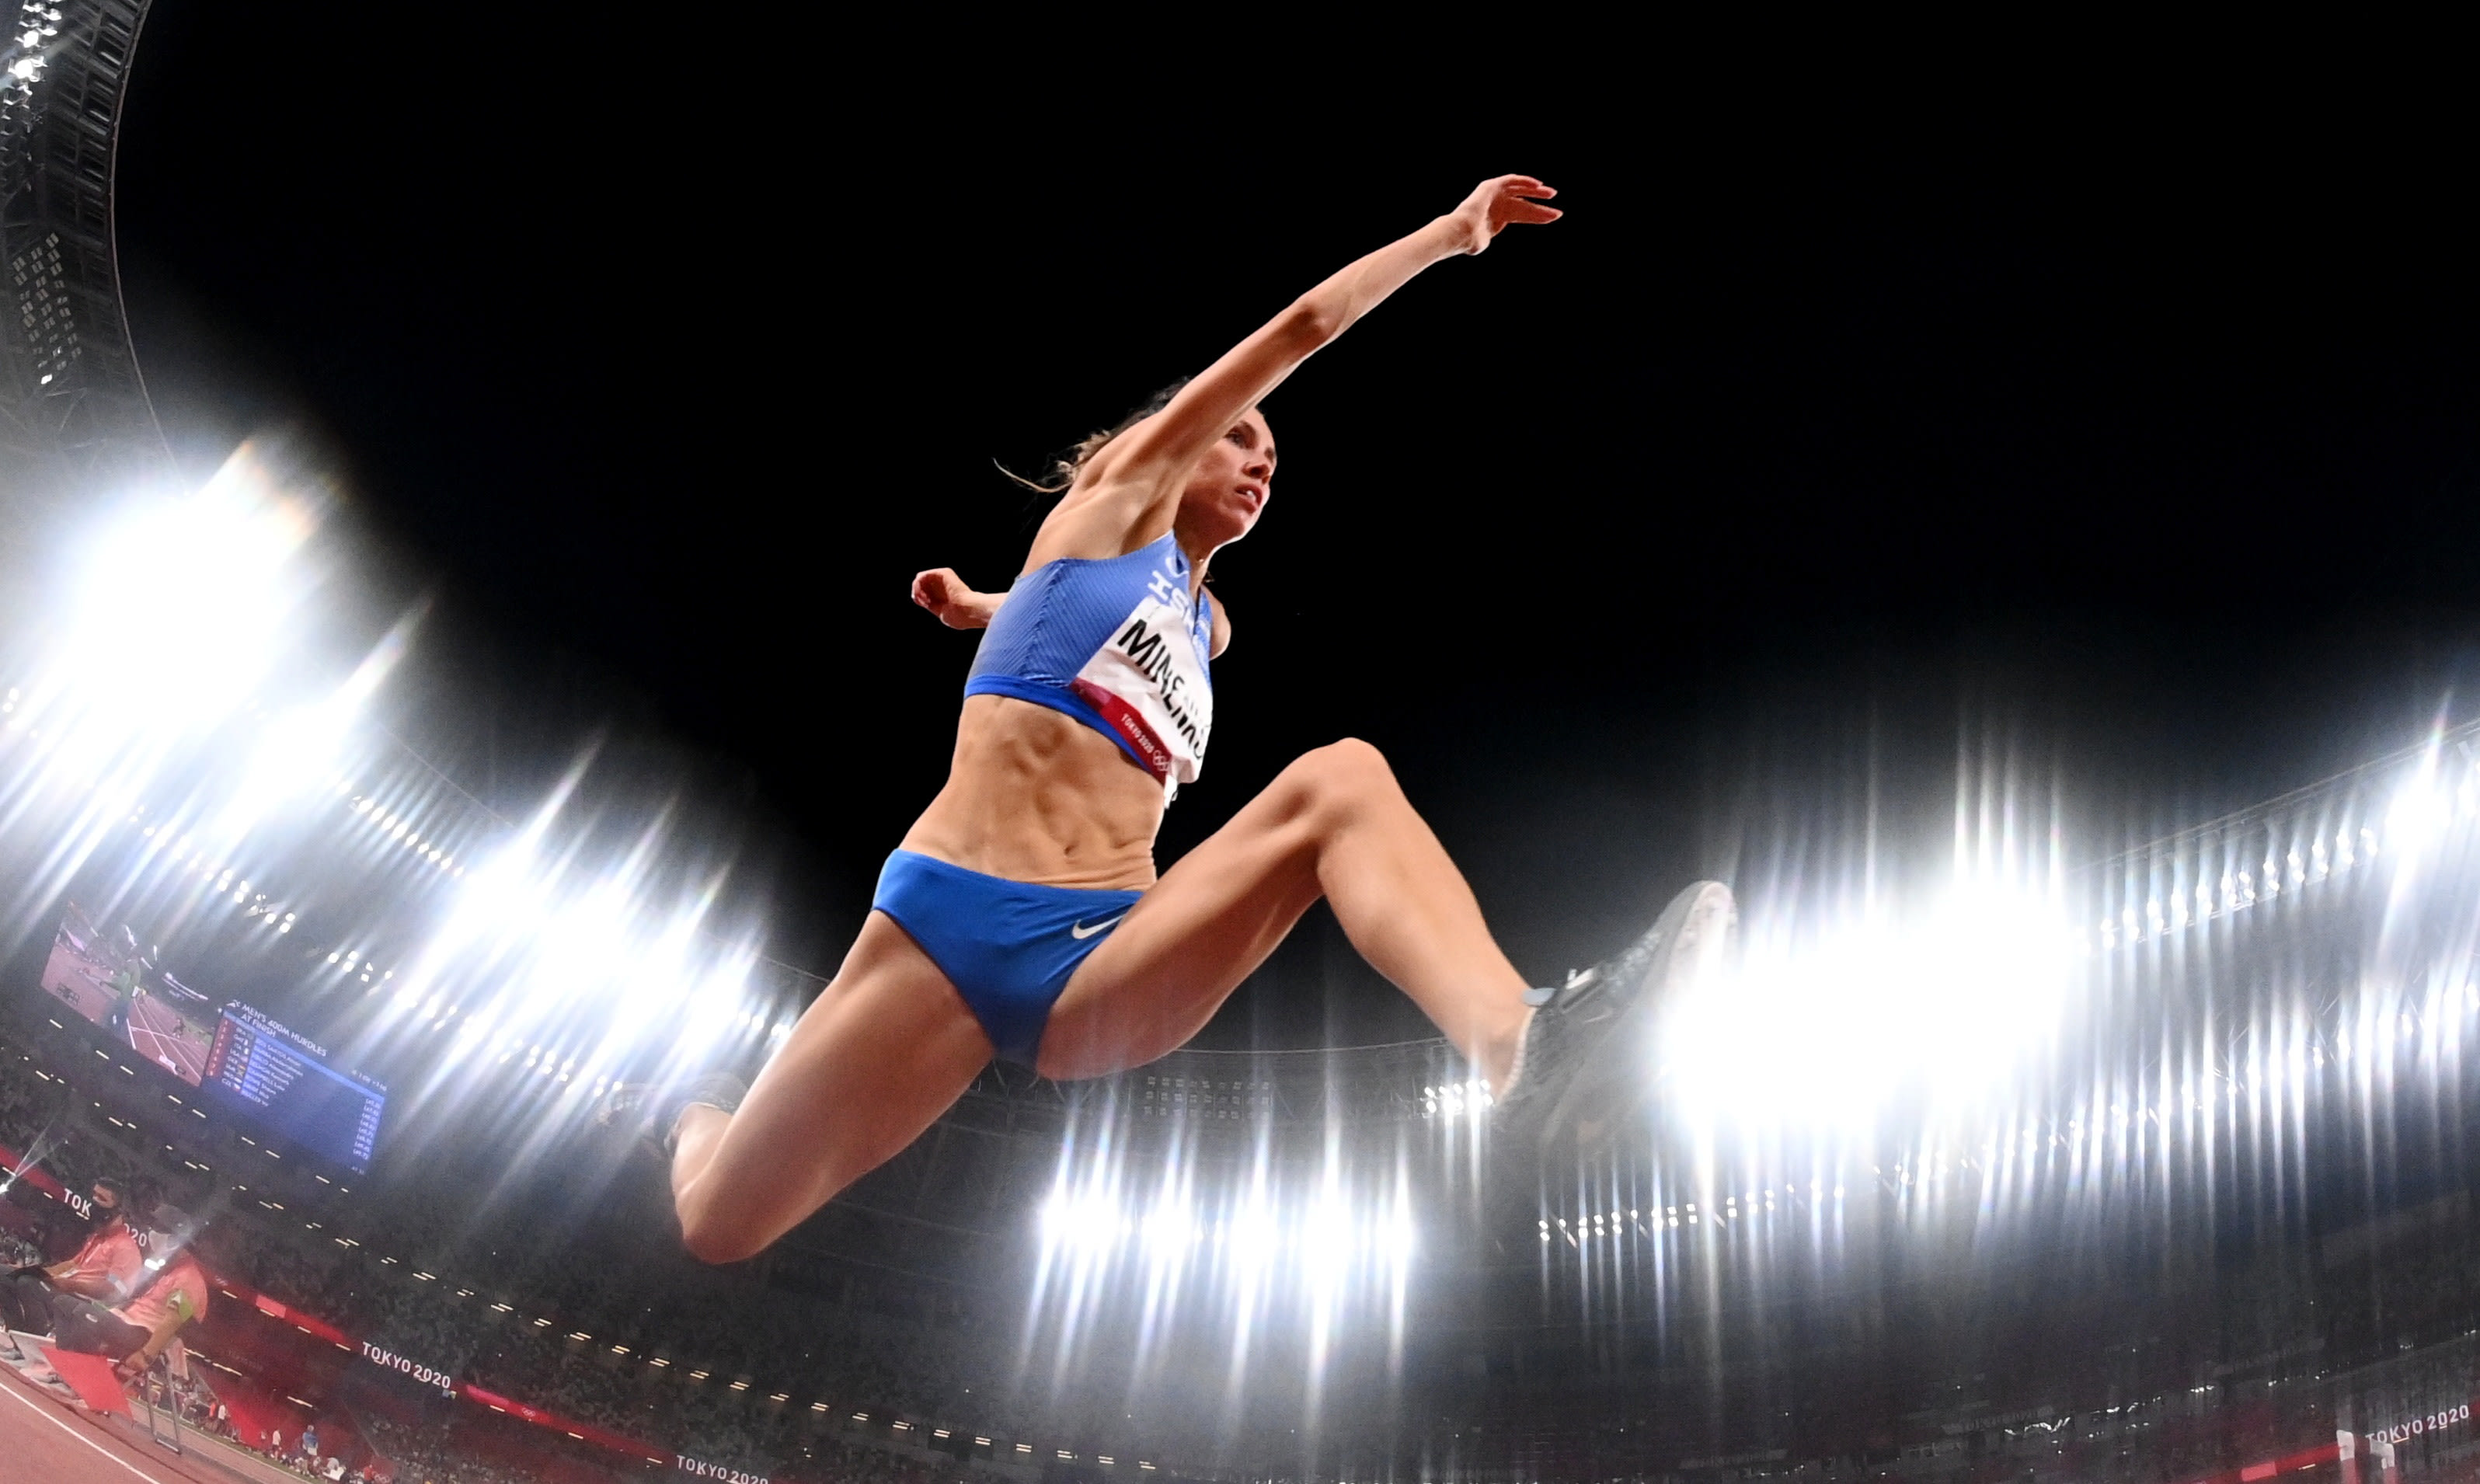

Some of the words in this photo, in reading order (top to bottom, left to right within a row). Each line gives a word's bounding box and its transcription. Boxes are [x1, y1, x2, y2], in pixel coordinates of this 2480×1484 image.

[1120, 712, 1141, 739] TOKYO
[1139, 733, 1155, 754] 2020
[241, 1013, 251, 1022] AT
[253, 1018, 277, 1038] FINISH
[242, 1003, 266, 1022] MEN'S
[267, 1019, 290, 1036] 400M
[291, 1031, 328, 1057] HURDLES
[64, 1187, 92, 1218] TOK
[362, 1340, 411, 1373] TOKYO
[413, 1364, 451, 1389] 2020
[2365, 1419, 2423, 1444] TOKYO
[2426, 1404, 2470, 1430] 2020
[676, 1454, 728, 1480] TOKYO
